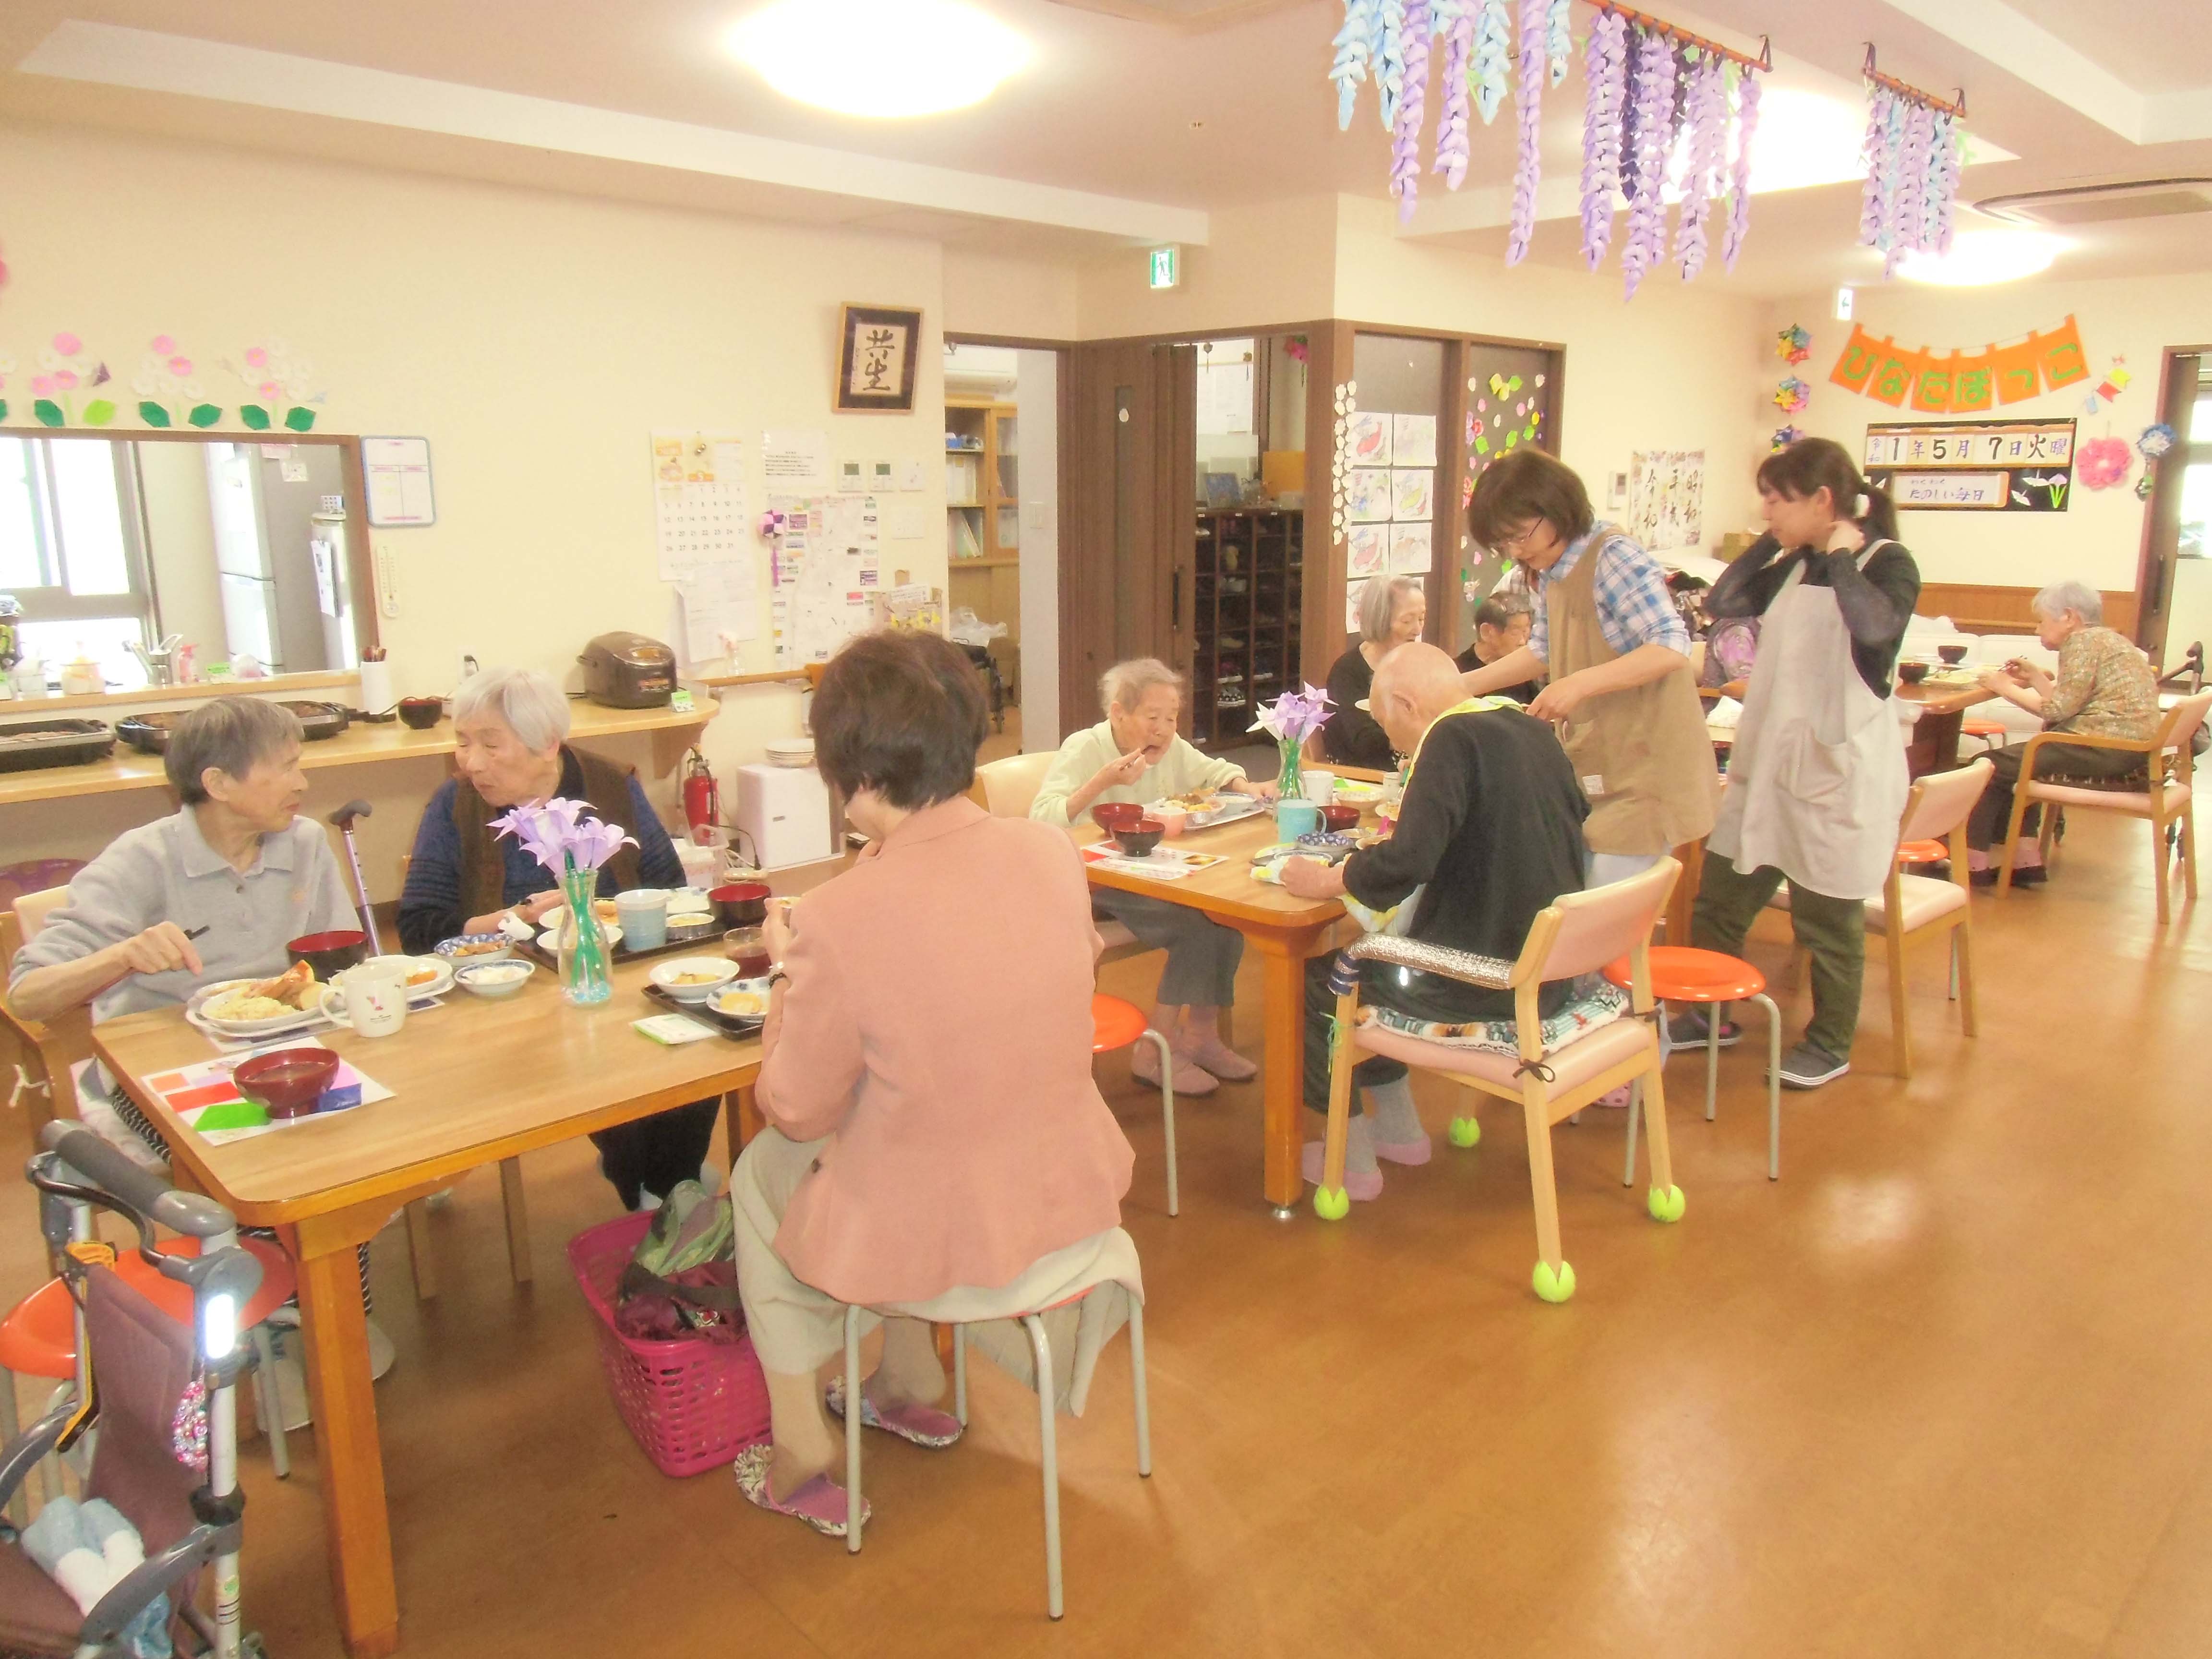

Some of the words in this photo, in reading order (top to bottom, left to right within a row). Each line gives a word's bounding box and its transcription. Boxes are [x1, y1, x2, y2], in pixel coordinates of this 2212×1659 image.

[863, 329, 895, 390] 共生
[1843, 343, 2084, 404] ひなたぼっこ
[1644, 469, 1658, 529] 令和
[1684, 469, 1698, 523] 昭和
[1910, 487, 1984, 501] たのしい毎日
